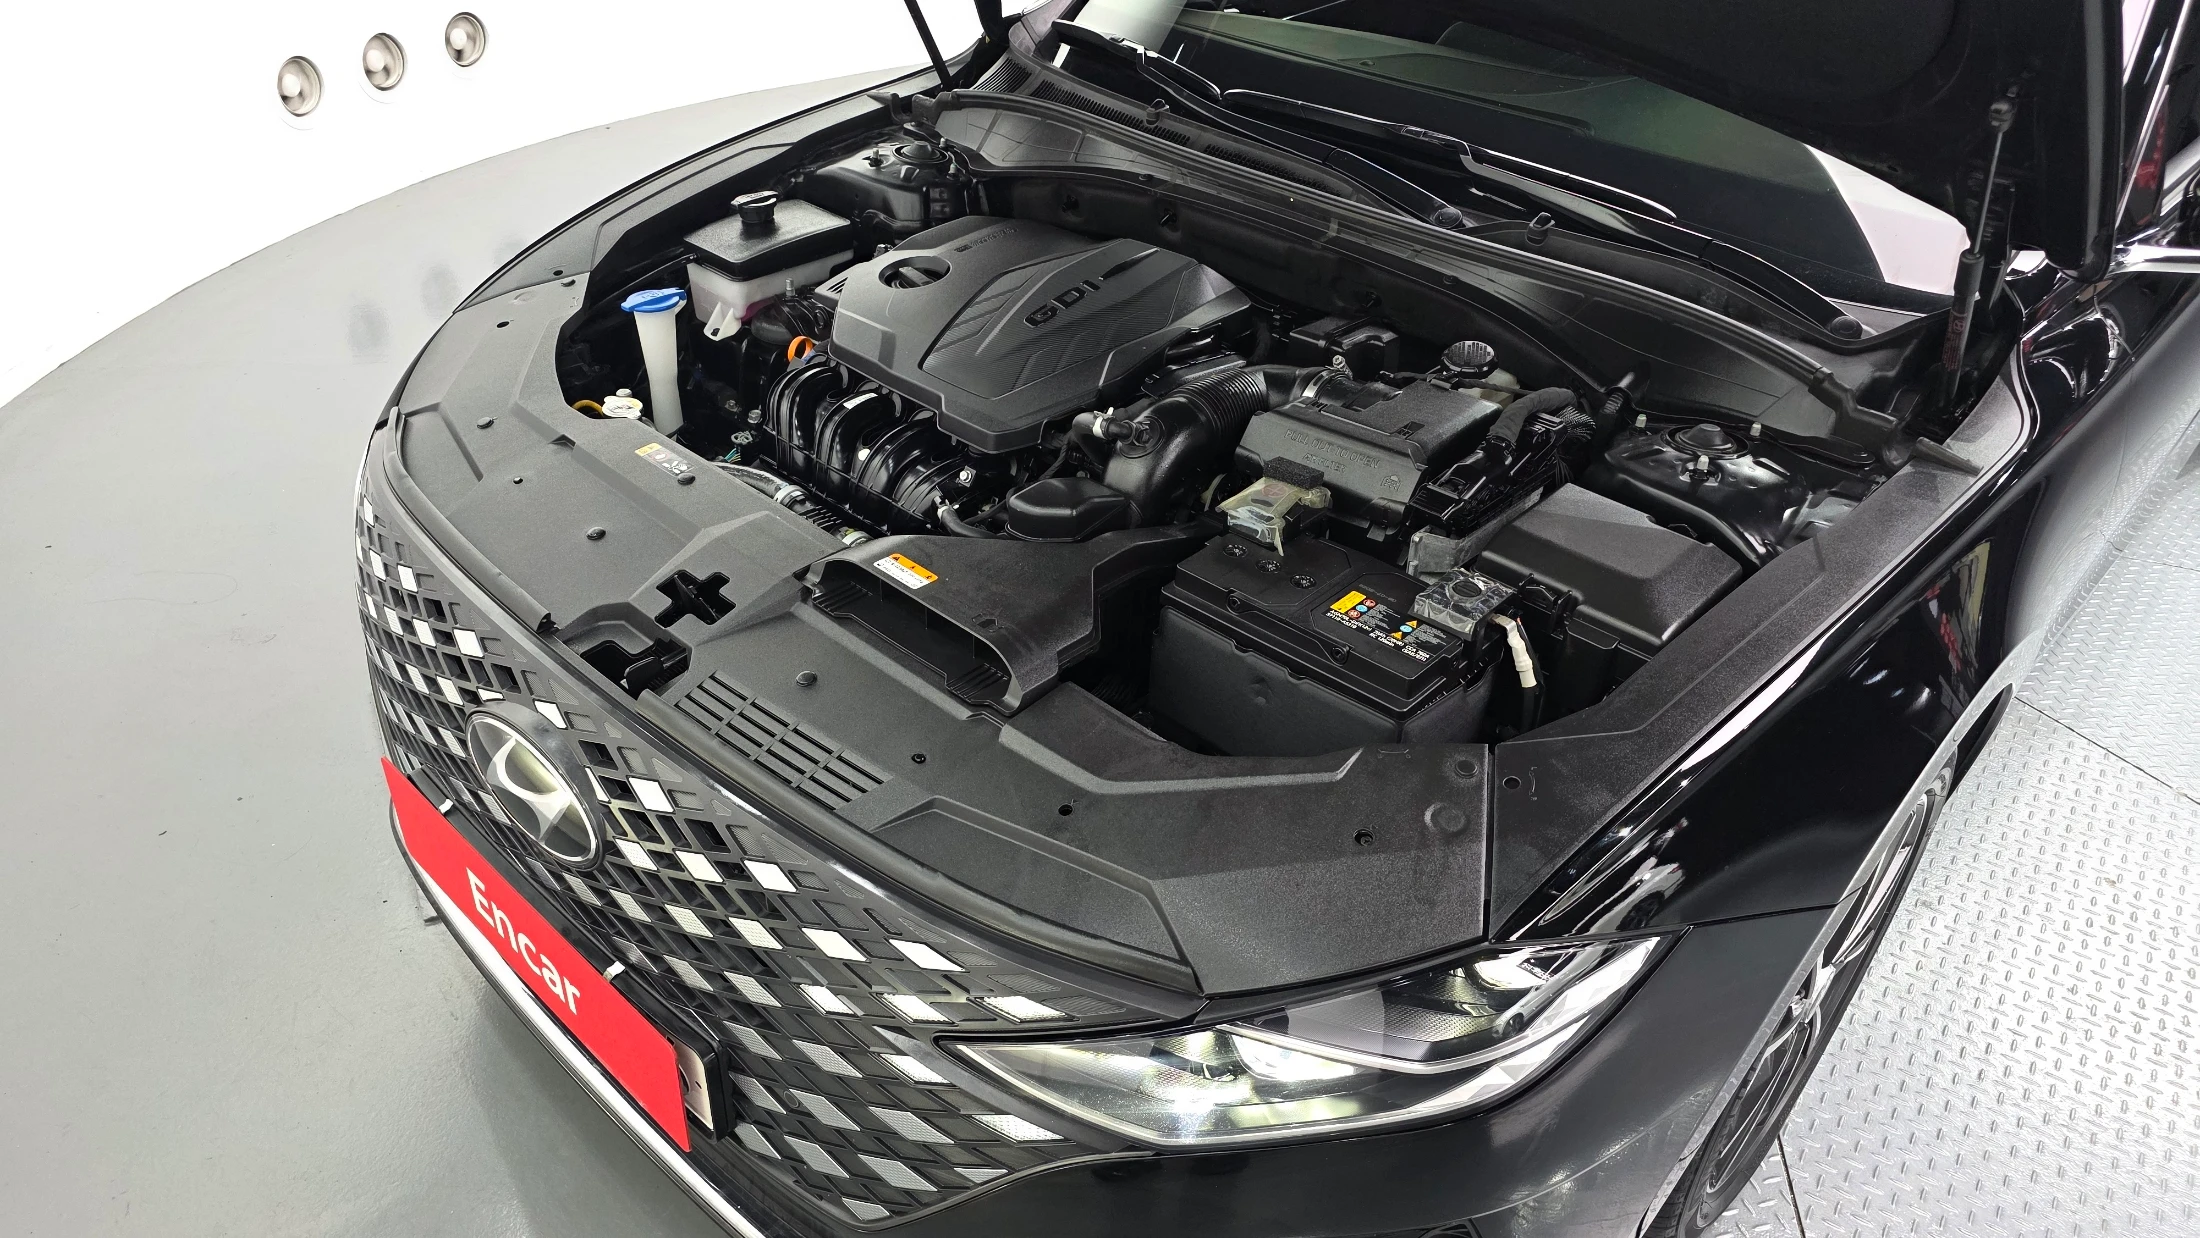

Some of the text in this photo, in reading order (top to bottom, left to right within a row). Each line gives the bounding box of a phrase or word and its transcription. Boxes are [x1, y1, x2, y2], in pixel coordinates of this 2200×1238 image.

[1024, 280, 1101, 328] GDI
[1284, 428, 1380, 469] PULL OUT TO OPEN
[465, 866, 581, 1016] Encar
